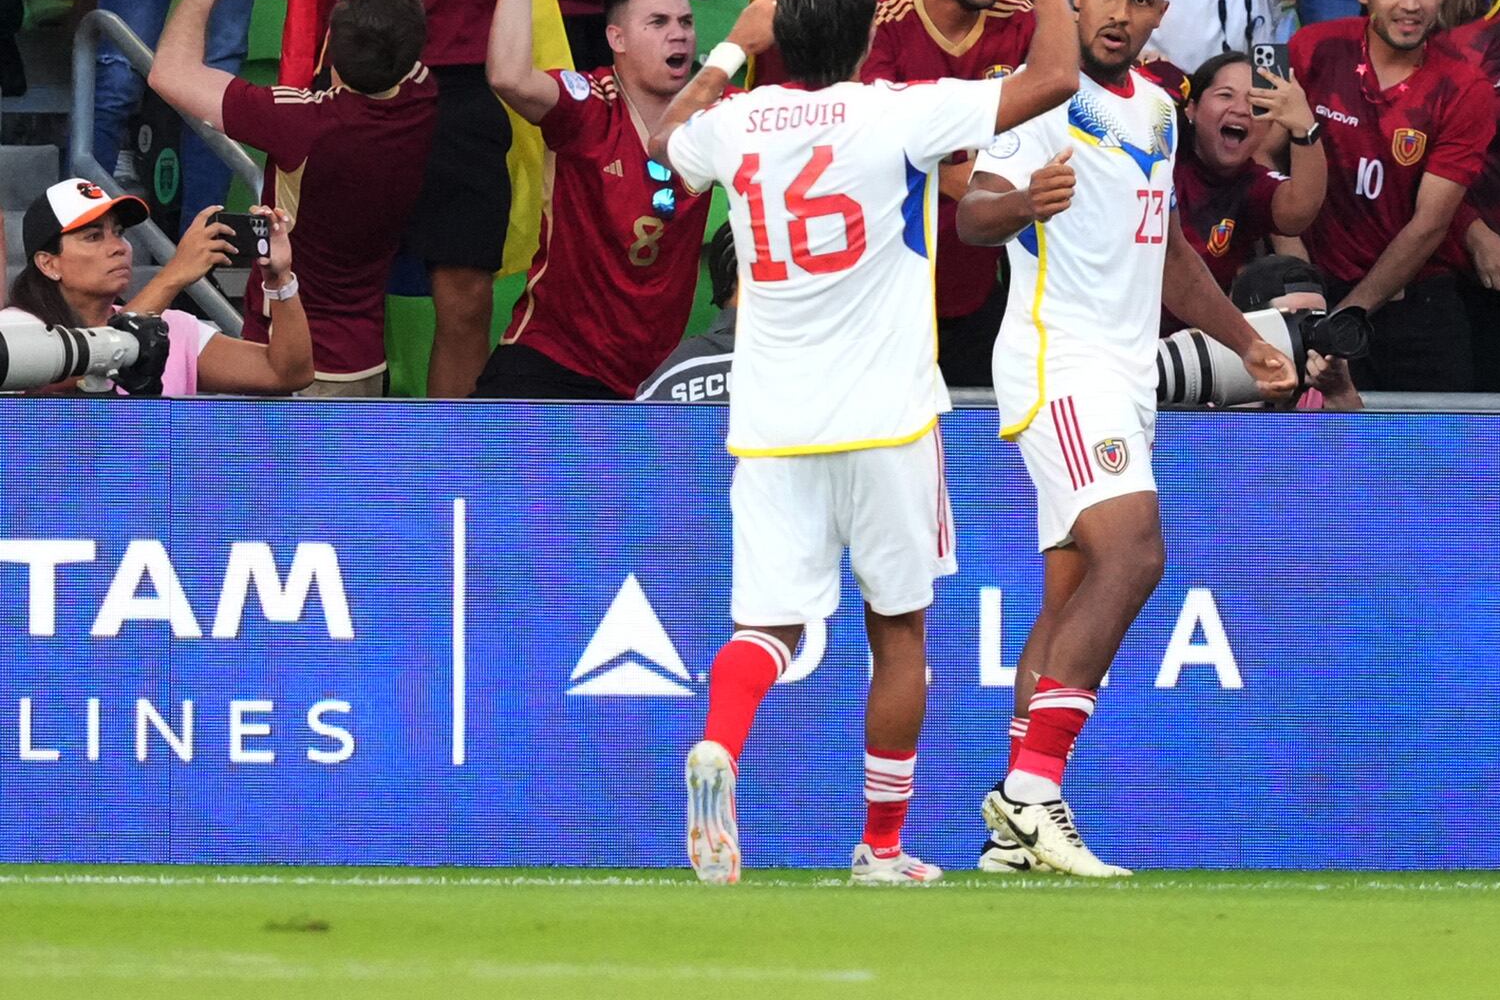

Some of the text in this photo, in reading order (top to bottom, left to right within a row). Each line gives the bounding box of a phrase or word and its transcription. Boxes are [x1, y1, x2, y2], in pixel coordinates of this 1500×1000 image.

[745, 101, 846, 133] SEGOVIA
[1315, 104, 1359, 127] GIVOVA
[1356, 157, 1384, 200] 10
[732, 145, 867, 282] 16
[1134, 189, 1165, 245] 23
[628, 214, 665, 268] 8
